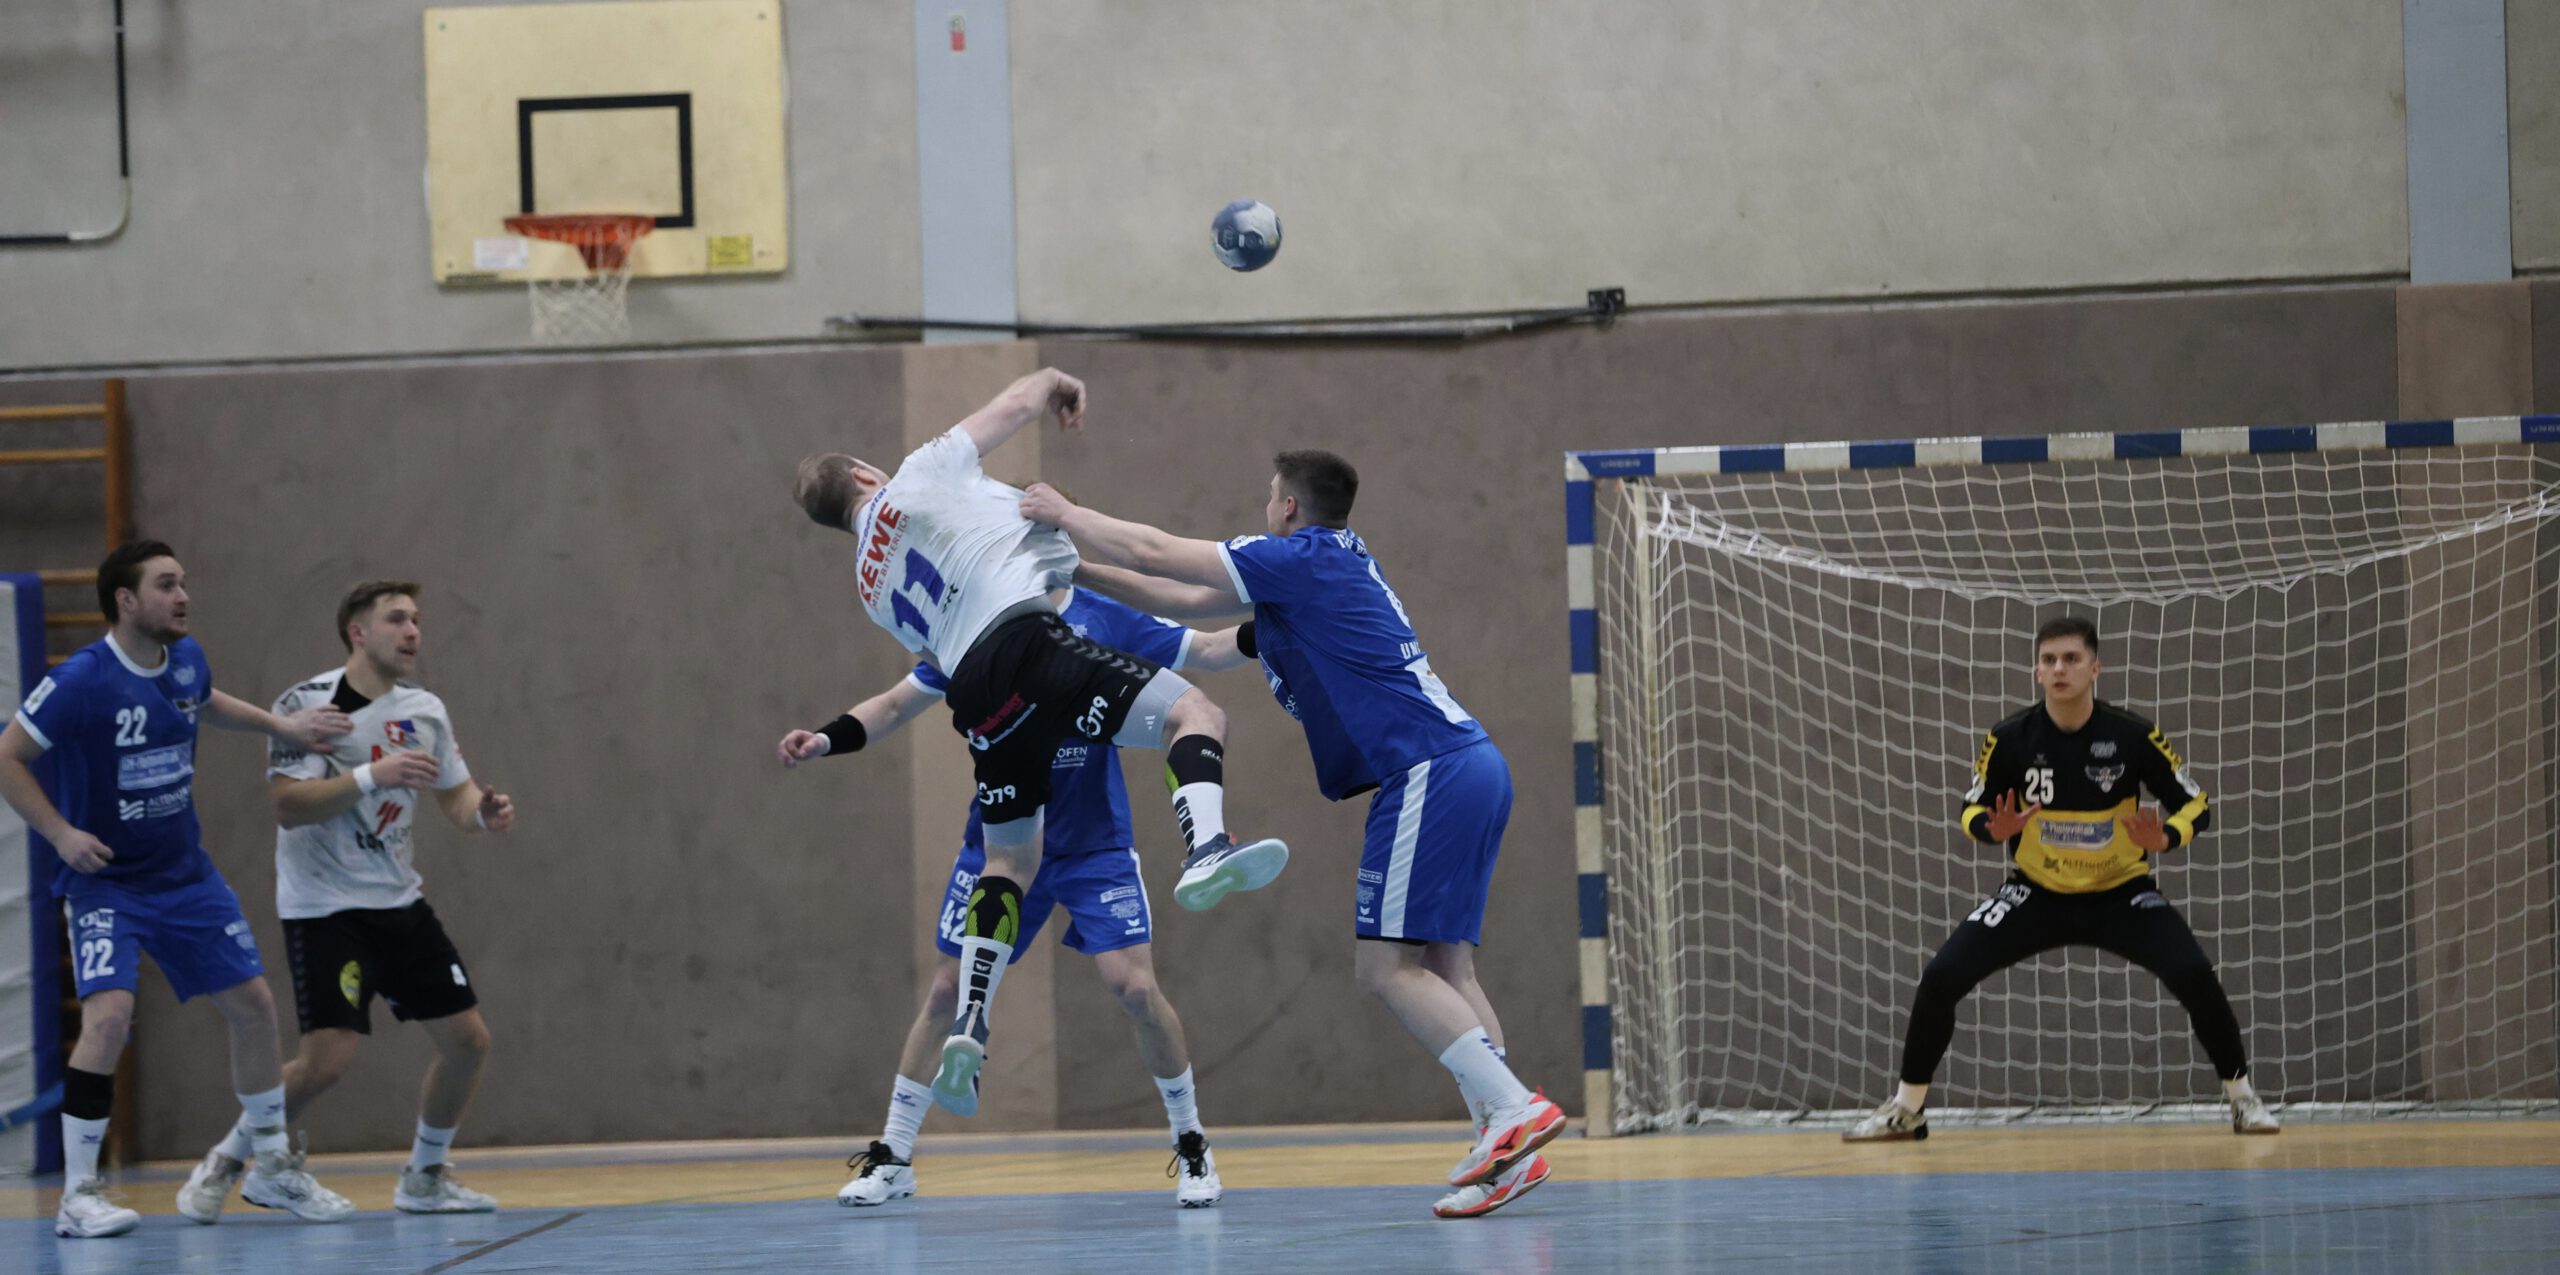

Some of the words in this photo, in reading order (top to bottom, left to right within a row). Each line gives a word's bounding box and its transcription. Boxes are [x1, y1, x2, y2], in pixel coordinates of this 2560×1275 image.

[882, 514, 910, 576] BITTERLICH
[891, 547, 946, 641] 11
[115, 705, 148, 747] 22
[2025, 767, 2055, 805] 25
[940, 900, 968, 946] 42
[1966, 898, 2013, 929] 25
[81, 938, 116, 981] 22
